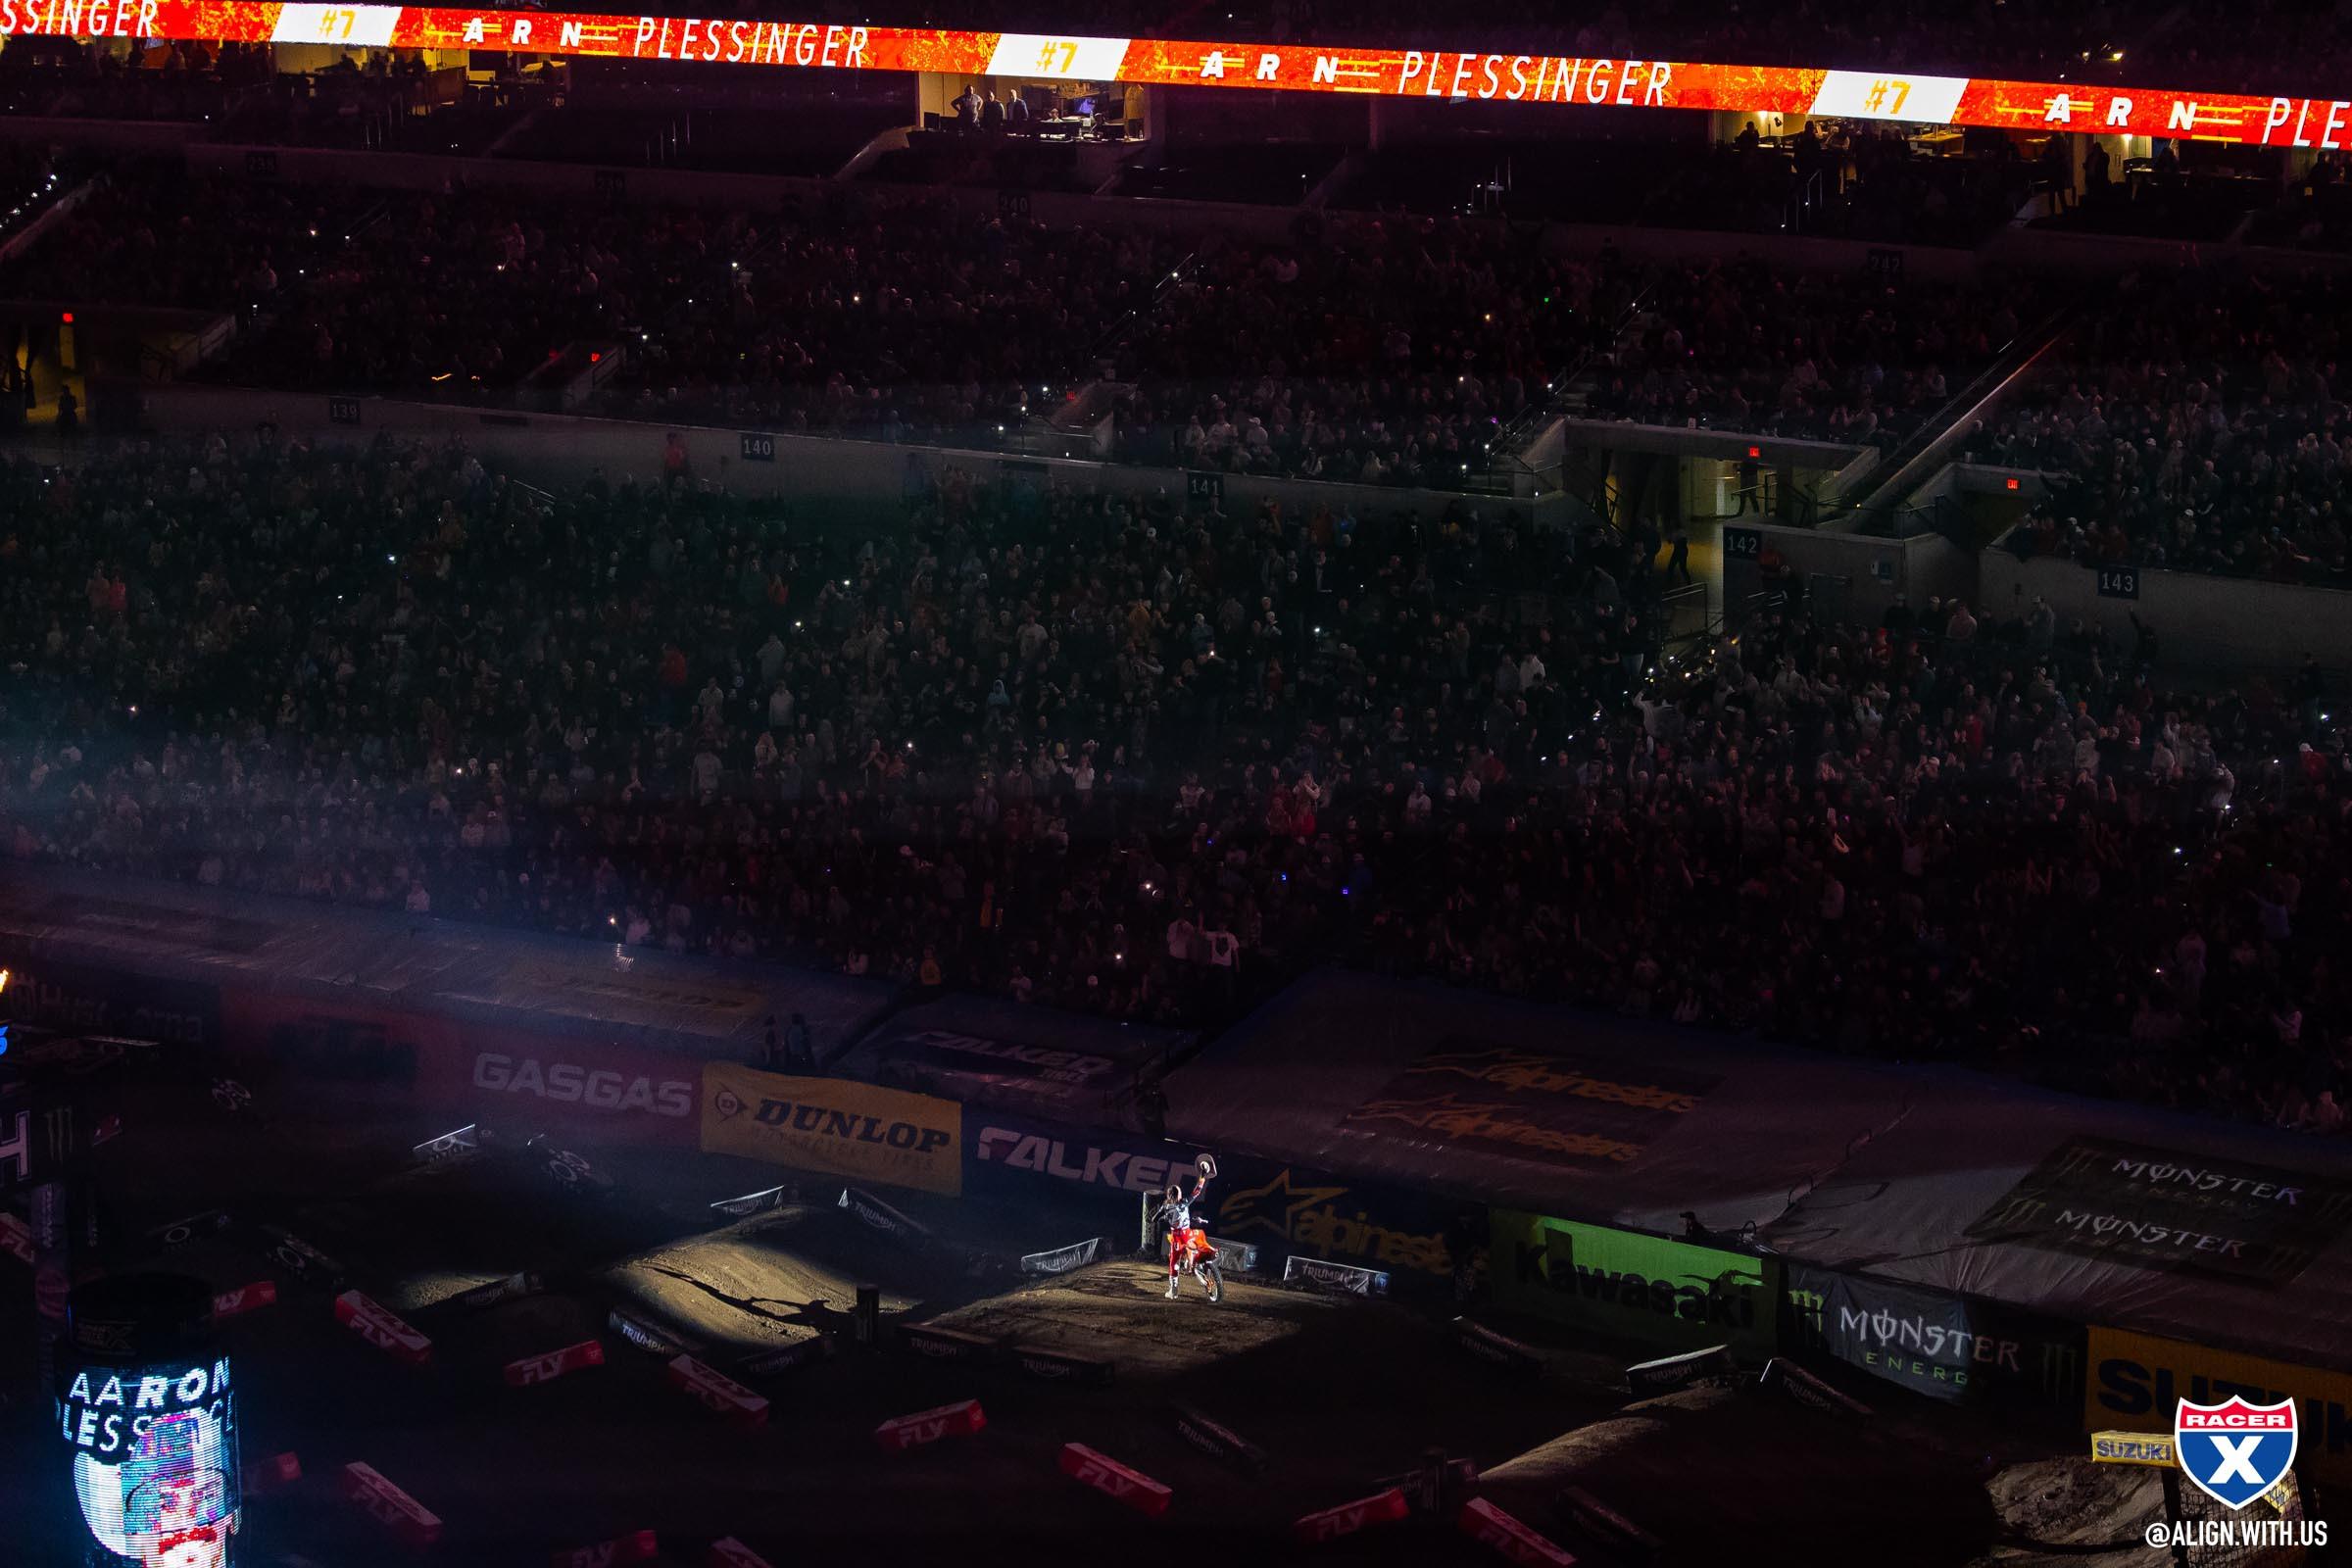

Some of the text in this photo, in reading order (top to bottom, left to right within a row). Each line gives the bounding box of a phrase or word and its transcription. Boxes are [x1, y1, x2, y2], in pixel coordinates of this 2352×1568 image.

[318, 9, 358, 38] #7
[633, 16, 869, 68] PLESSINGER
[1035, 40, 1080, 74] #7
[1398, 50, 1672, 107] PLESSINGER
[1864, 78, 1911, 115] #7
[332, 403, 358, 419] 139
[744, 438, 771, 456] 140
[1191, 477, 1220, 497] 141
[1728, 533, 1758, 555] 142
[2101, 571, 2134, 593] 143
[472, 1052, 692, 1117] GASGAS
[753, 1098, 951, 1153] DUNLOP
[855, 1201, 897, 1233] TRIUMPH
[623, 1321, 666, 1353] TRIUMPH
[909, 1338, 957, 1357] TRIUMPH
[69, 1356, 229, 1409] AARON
[522, 1354, 565, 1384] FLY
[1784, 1375, 1832, 1412] TRIUMPH
[899, 1418, 949, 1448] FLY
[2096, 1440, 2172, 1461] SUZUKI
[1078, 1460, 1137, 1497] FLY
[1316, 1506, 1366, 1542] FLY
